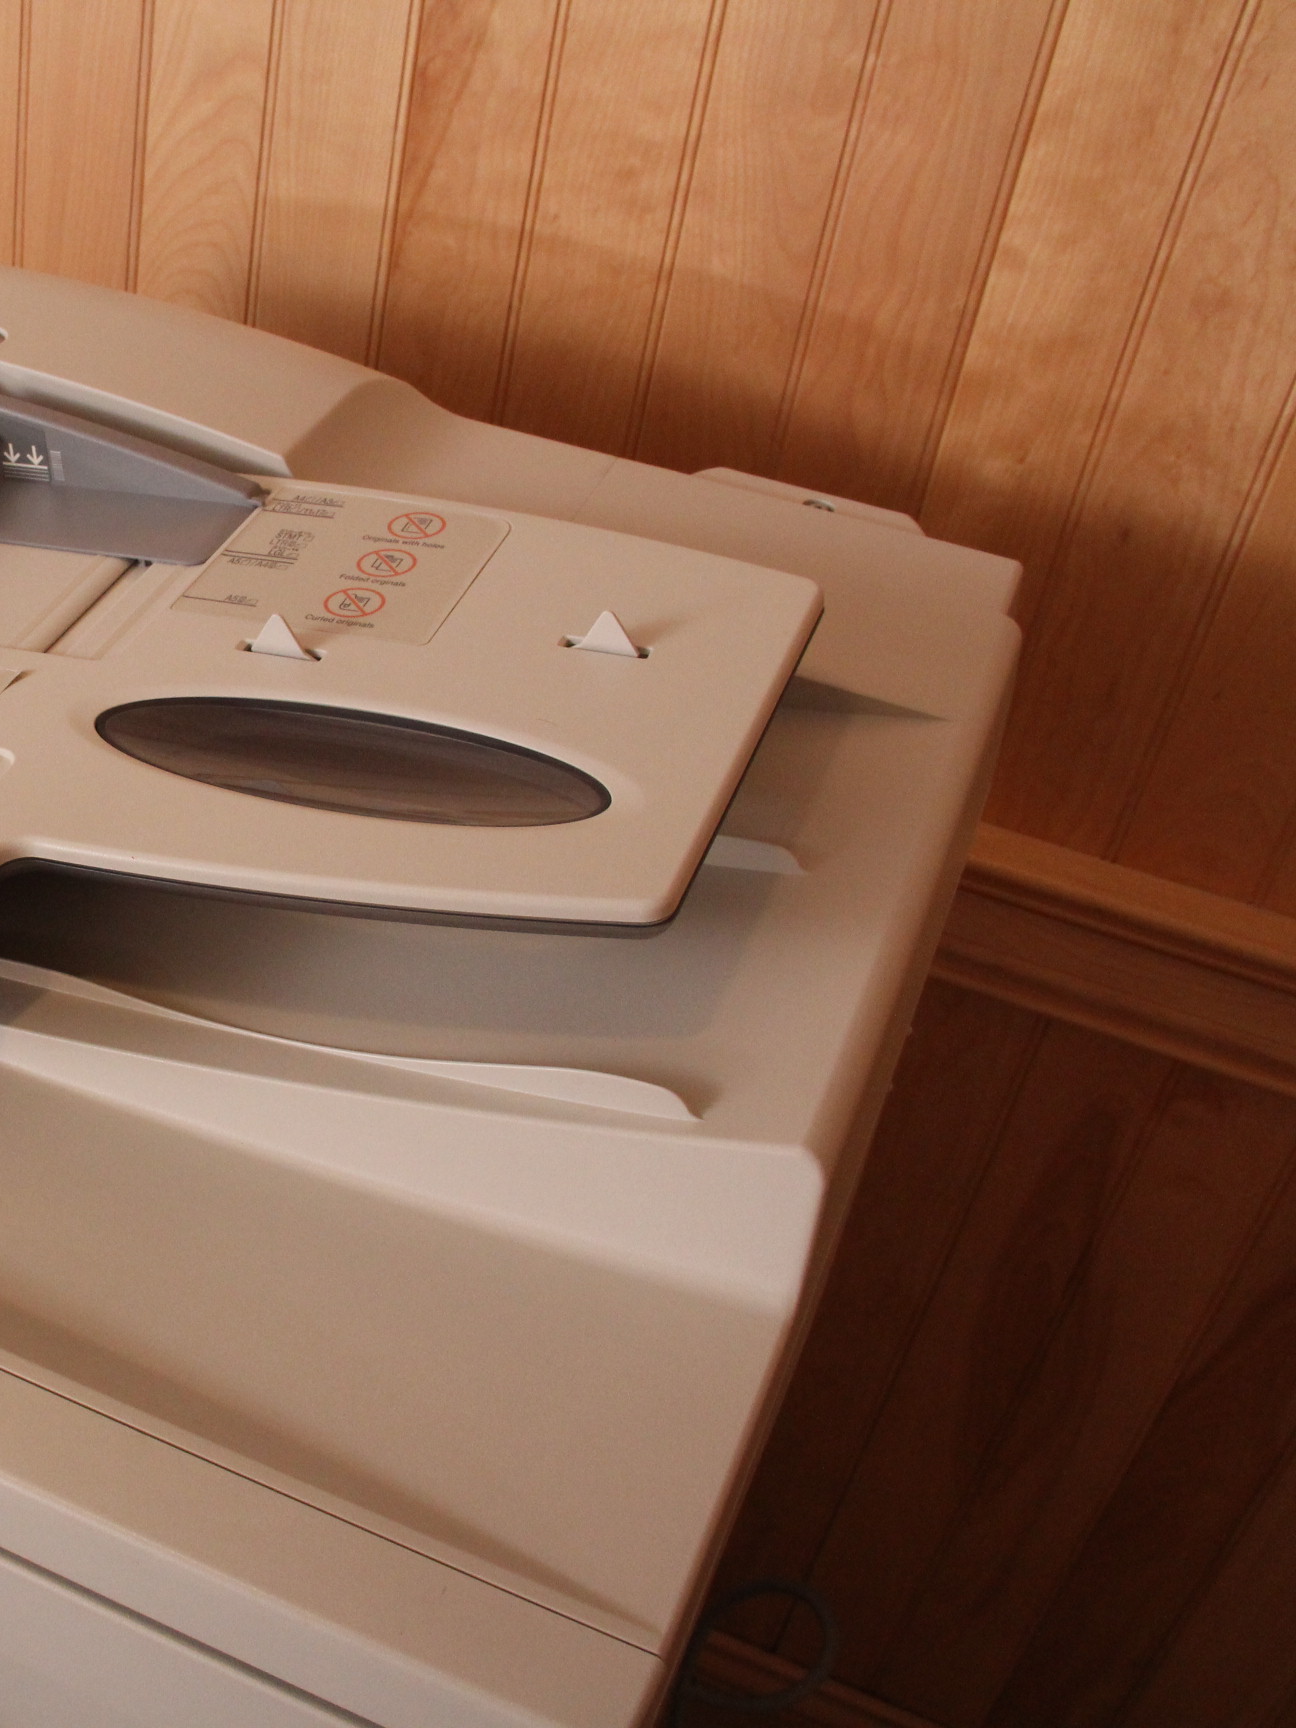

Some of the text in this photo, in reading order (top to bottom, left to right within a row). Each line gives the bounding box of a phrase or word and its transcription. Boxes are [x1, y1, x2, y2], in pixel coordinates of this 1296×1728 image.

[362, 534, 445, 549] Originals with holes
[339, 573, 370, 583] Folded
[305, 614, 374, 629] Curled originals
